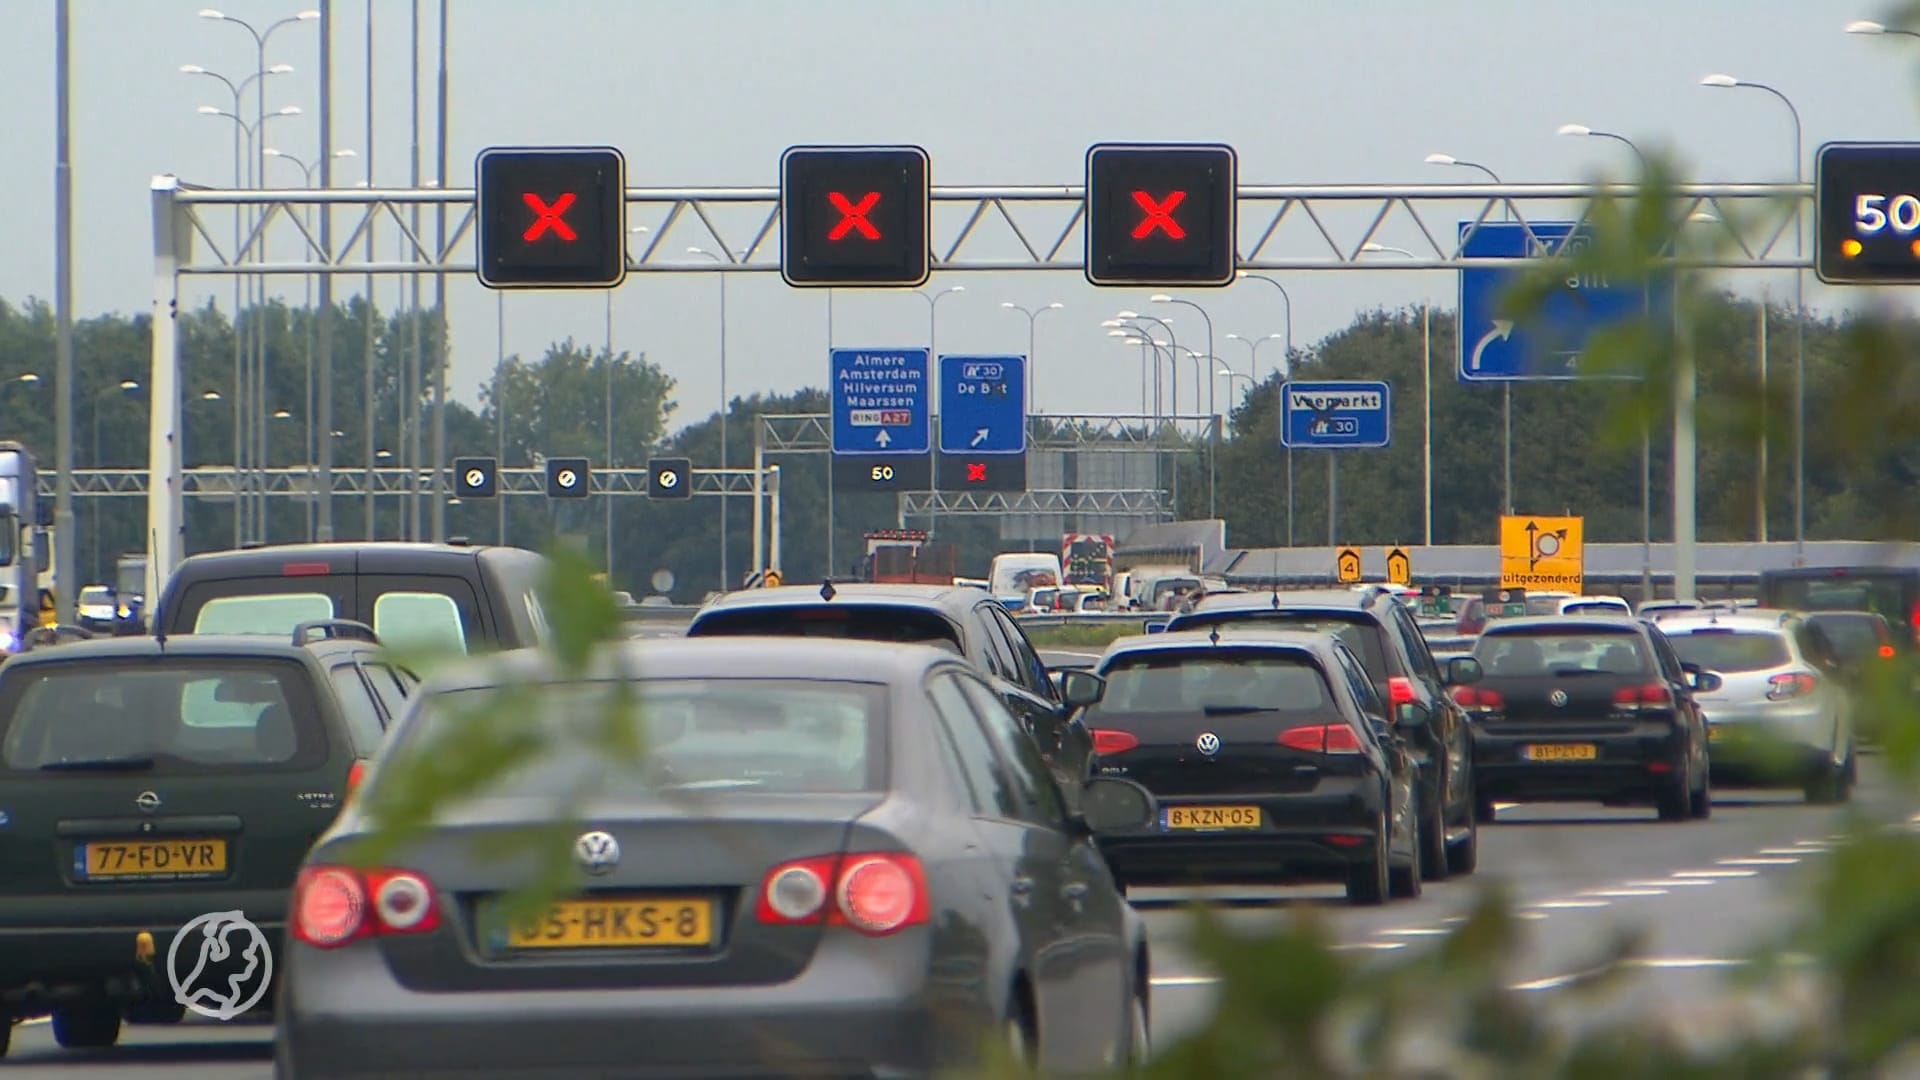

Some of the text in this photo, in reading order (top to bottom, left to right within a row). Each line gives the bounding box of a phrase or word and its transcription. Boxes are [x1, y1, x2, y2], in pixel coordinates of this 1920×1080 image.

[1855, 194, 1920, 231] 50
[855, 355, 905, 366] Almere
[840, 369, 920, 380] Amsterdam
[983, 367, 998, 376] 30
[844, 383, 917, 393] Hilversum
[958, 383, 1007, 394] De Bt
[847, 396, 914, 406] Maarssen
[853, 413, 908, 422] RING A27
[1336, 422, 1354, 432] 30
[871, 466, 893, 480] 50
[1344, 562, 1354, 573] 4
[1503, 573, 1580, 585] uitgezonderd
[1172, 810, 1254, 825] 8-KZN-05
[98, 846, 214, 868] 77-FD-VR
